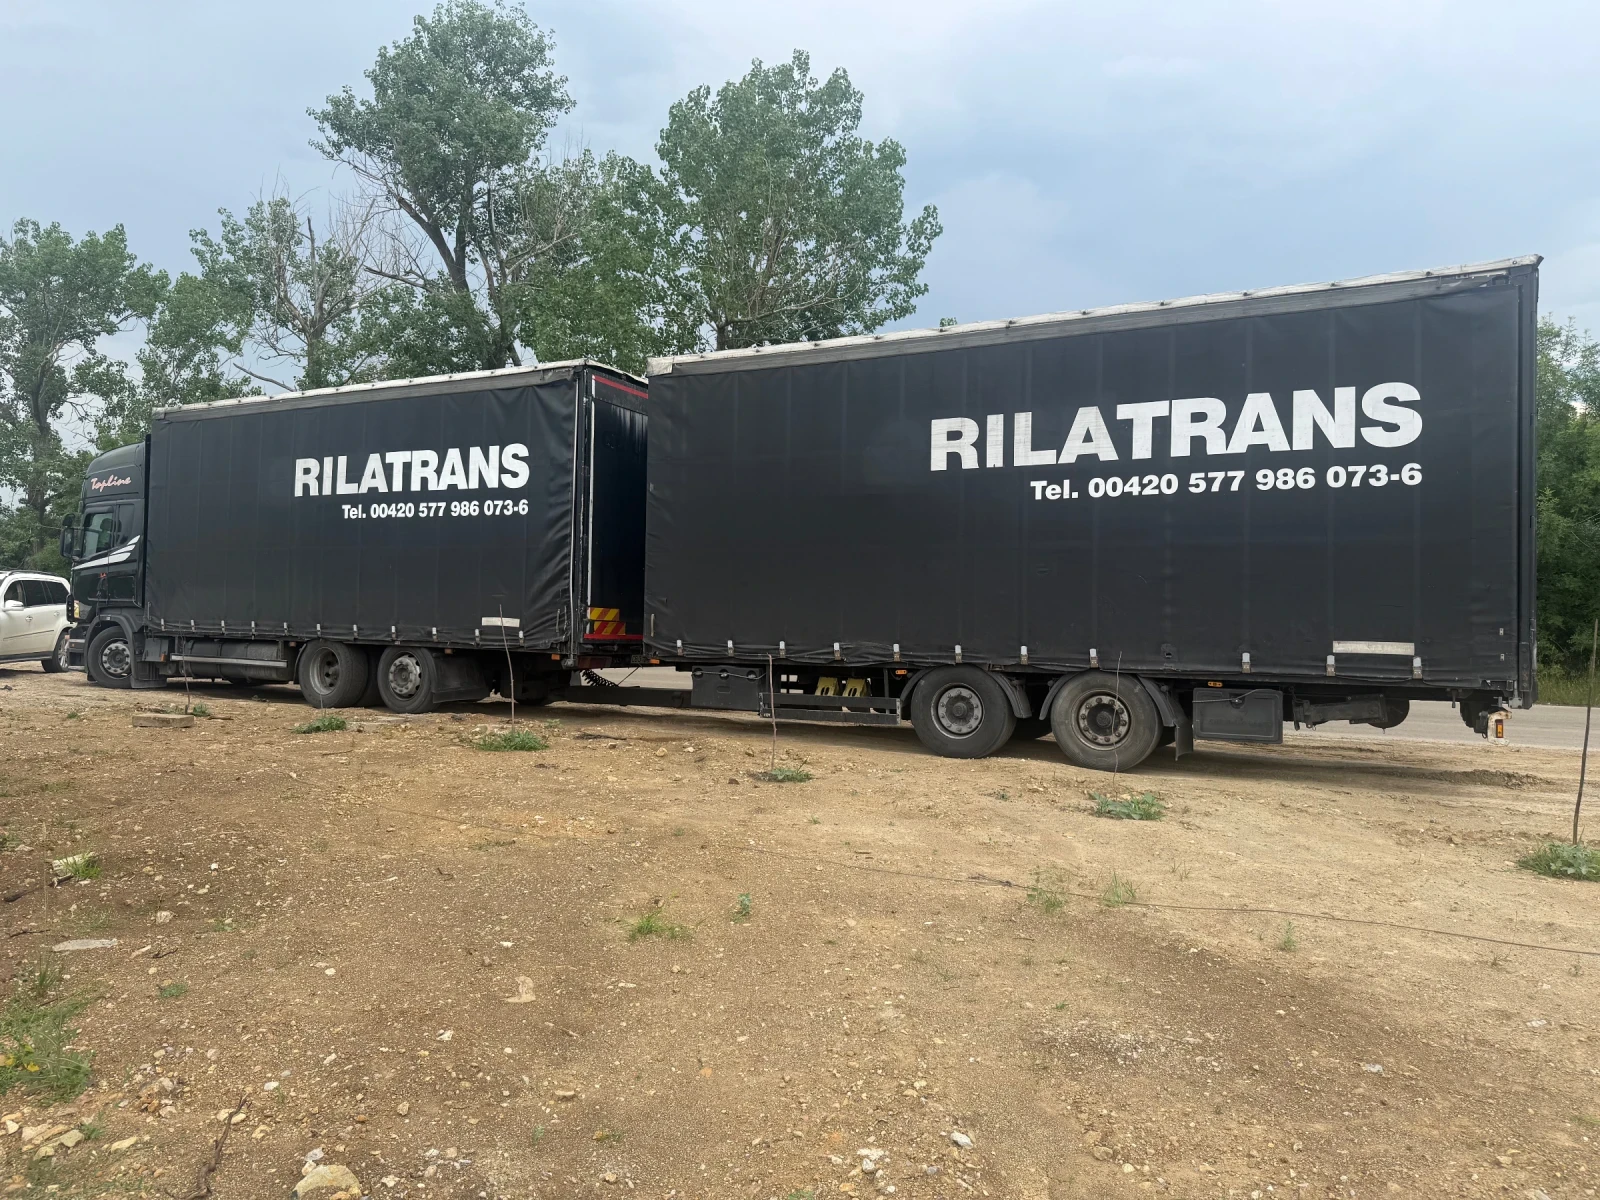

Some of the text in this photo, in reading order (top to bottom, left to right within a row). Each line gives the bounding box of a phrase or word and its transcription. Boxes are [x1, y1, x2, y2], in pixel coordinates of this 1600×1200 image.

[930, 382, 1423, 471] RILATRANS
[91, 474, 131, 493] Topline
[294, 443, 530, 497] RILATRANS
[1030, 463, 1423, 501] Tel. 00420 577 986 073-6
[341, 499, 529, 519] Tel. 00420 577 986 073-6
